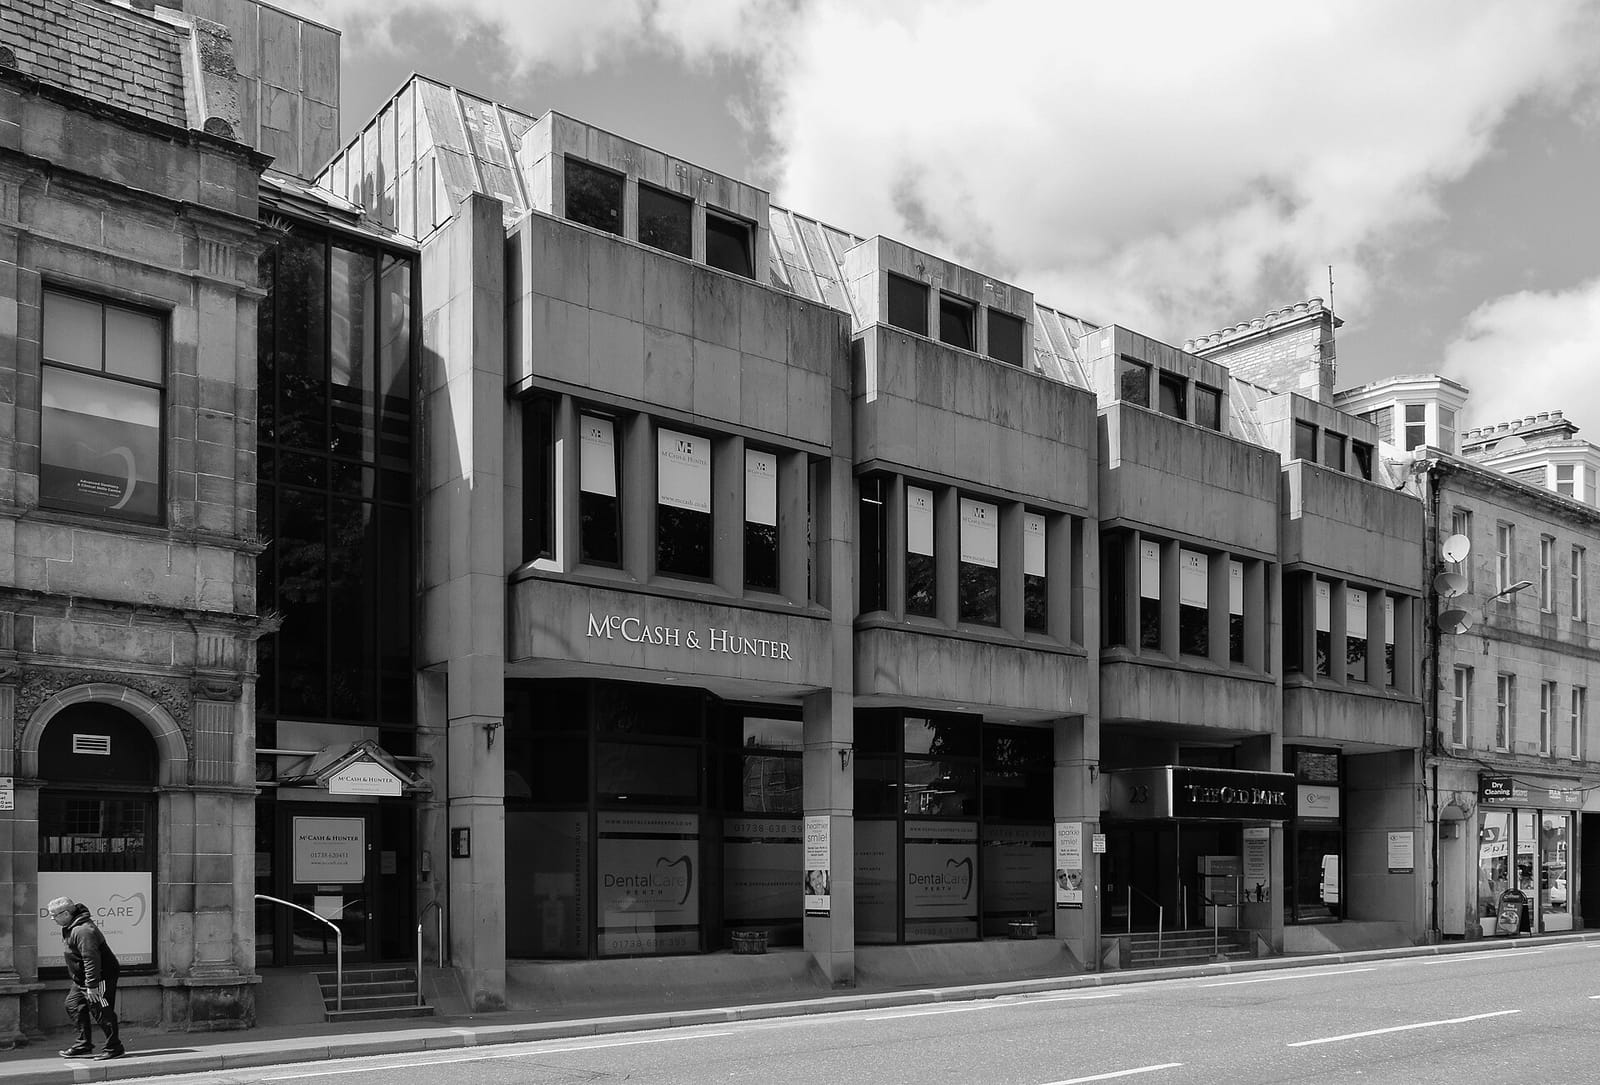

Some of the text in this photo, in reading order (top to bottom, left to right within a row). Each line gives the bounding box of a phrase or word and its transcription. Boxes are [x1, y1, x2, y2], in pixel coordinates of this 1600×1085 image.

[686, 629, 702, 651] &
[709, 627, 794, 661] HUNTER
[1129, 785, 1148, 804] 23
[1251, 788, 1286, 806] BANK
[96, 906, 135, 918] CARE
